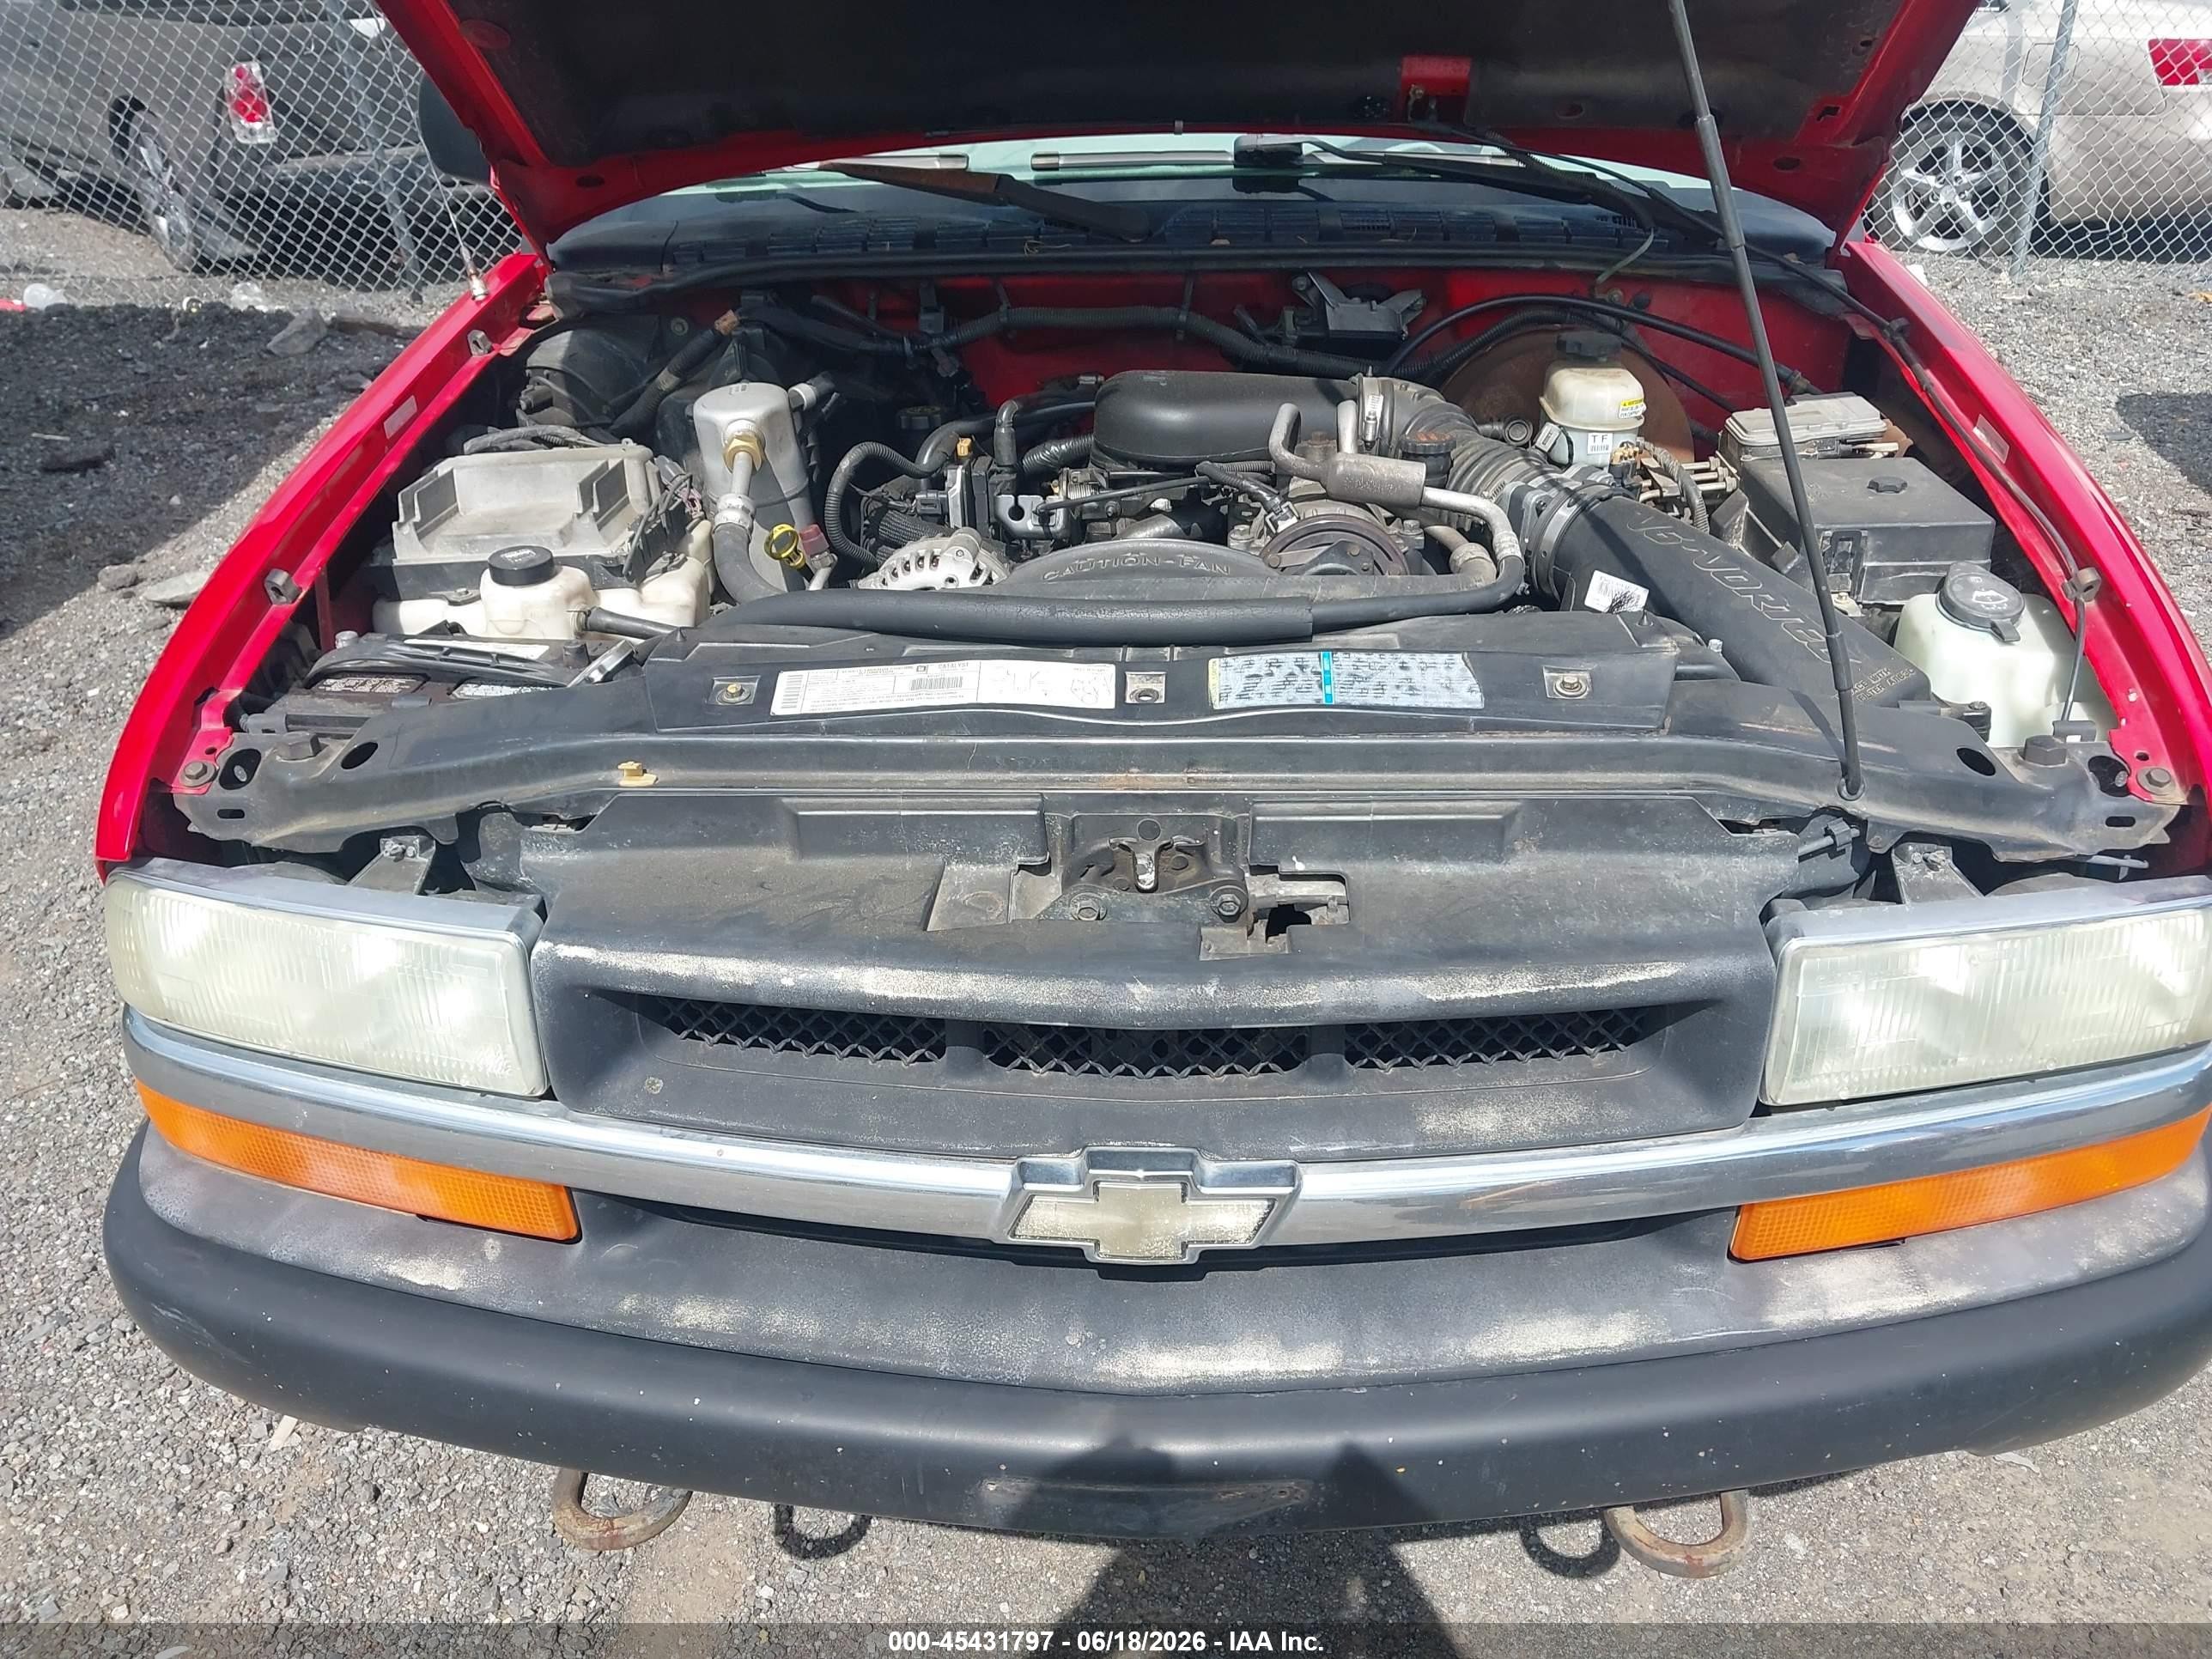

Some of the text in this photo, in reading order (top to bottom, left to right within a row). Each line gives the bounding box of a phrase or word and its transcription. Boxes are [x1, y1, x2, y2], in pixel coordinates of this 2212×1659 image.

[1042, 552, 1159, 582] CAUTION
[1177, 553, 1231, 576] FAN
[1857, 684, 1885, 702] FILTER
